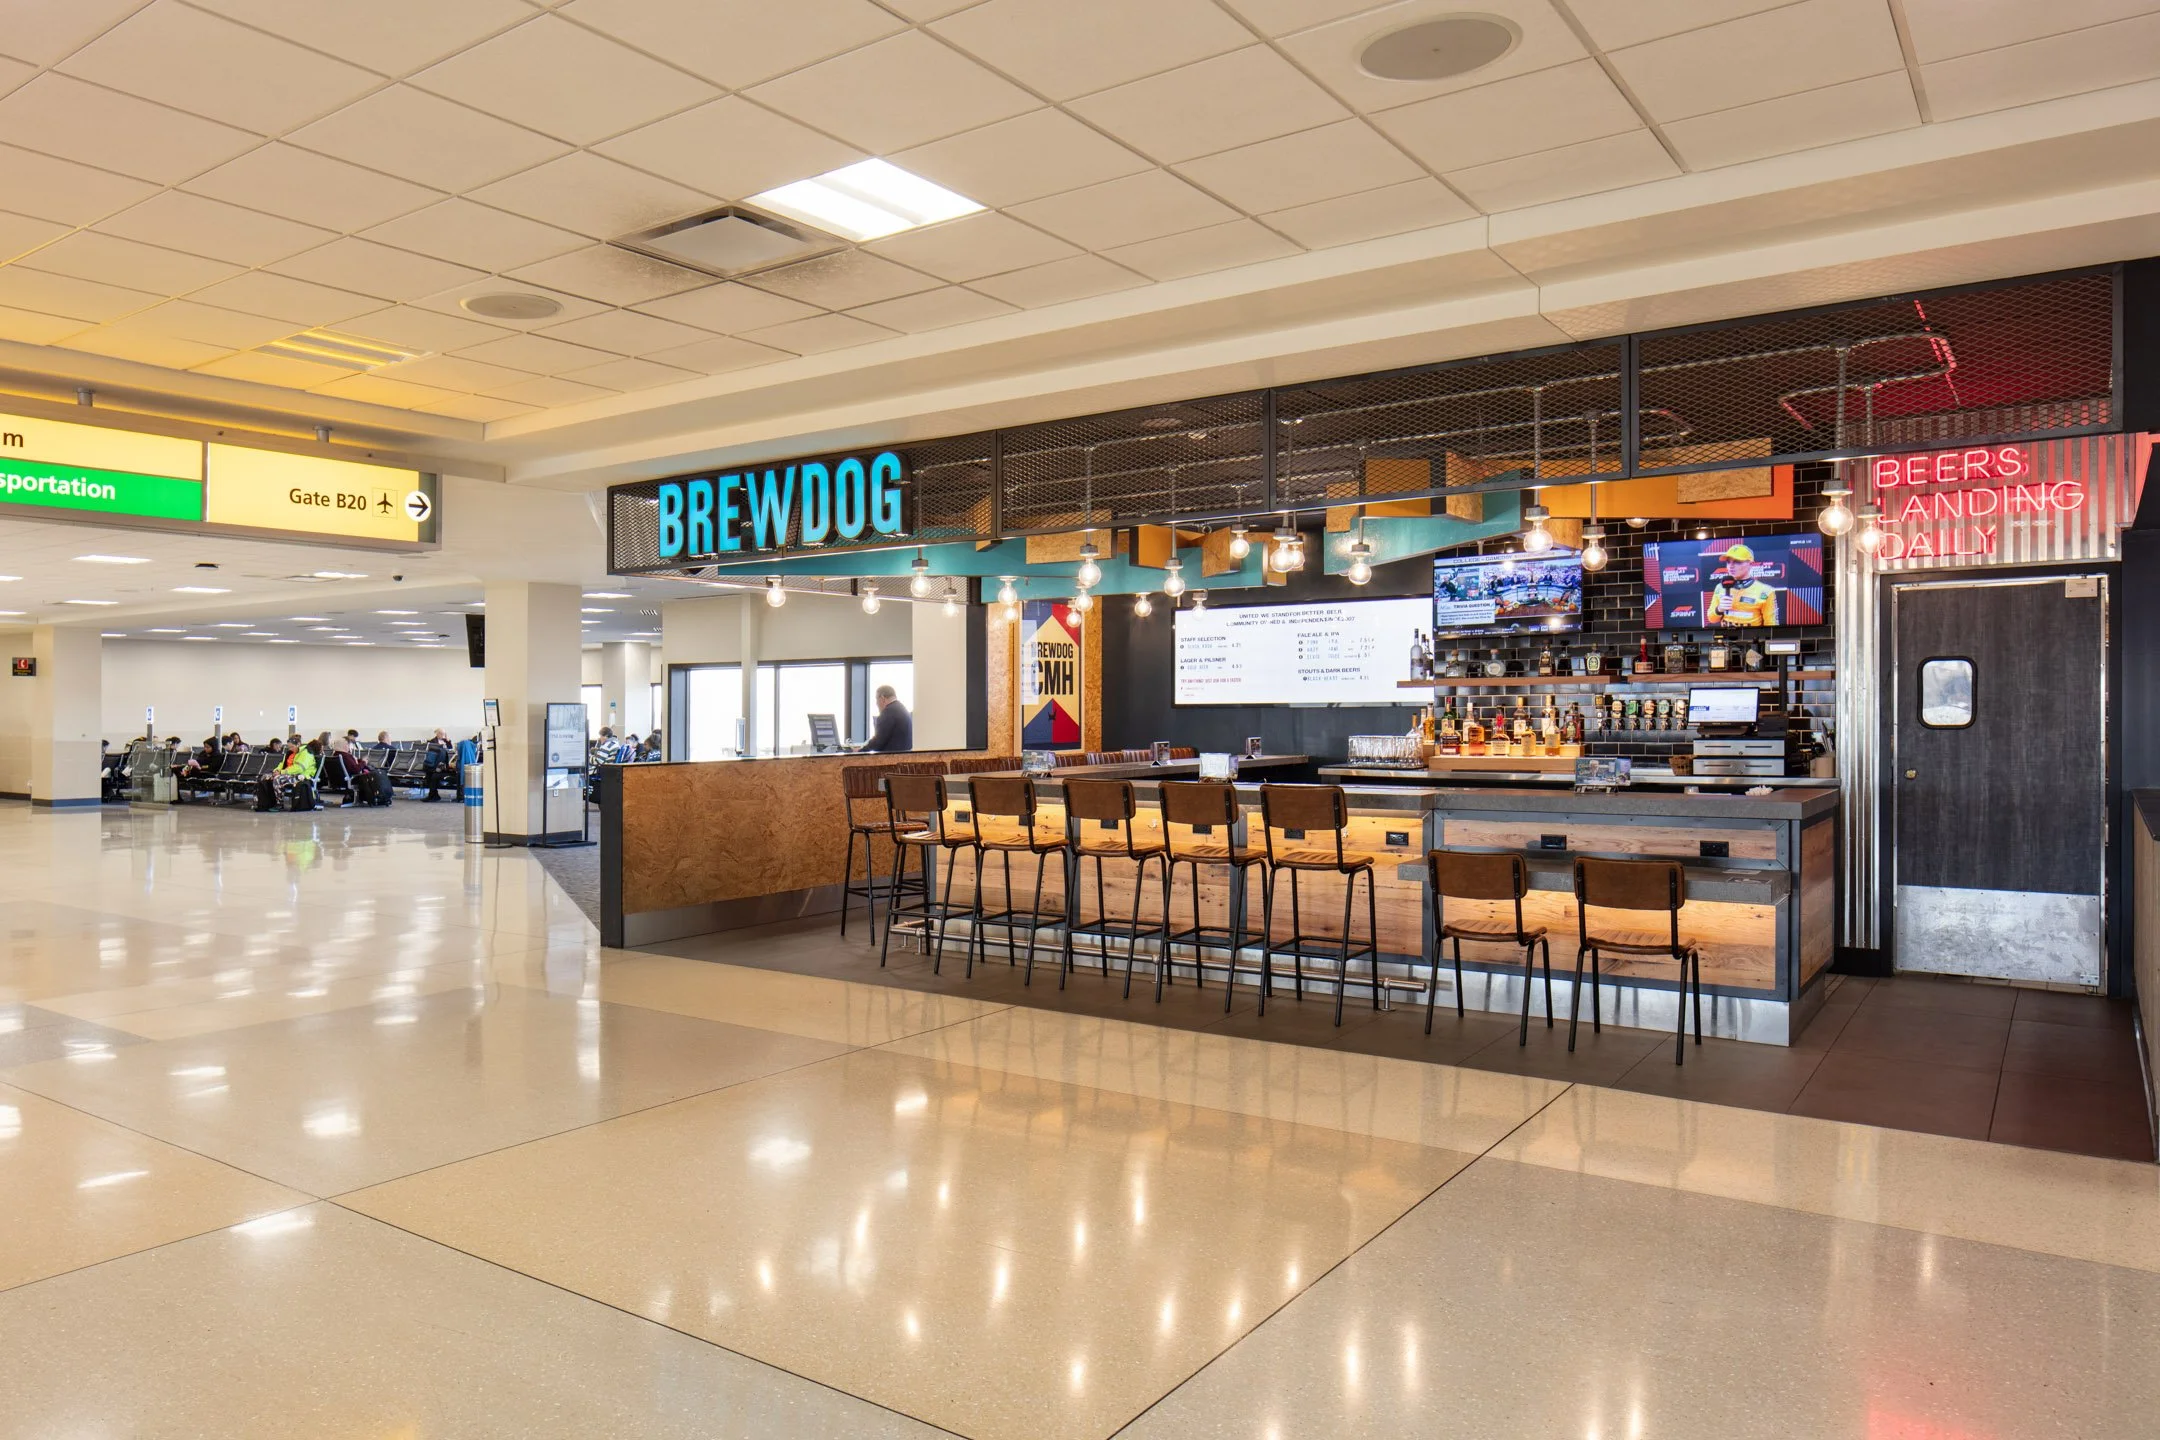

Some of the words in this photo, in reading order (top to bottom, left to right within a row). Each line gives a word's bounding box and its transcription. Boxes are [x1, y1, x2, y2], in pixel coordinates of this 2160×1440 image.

[3, 432, 24, 447] m
[1876, 447, 2022, 488] BEERS
[0, 472, 116, 500] sportation
[289, 488, 330, 508] Gate
[336, 493, 367, 511] B20
[1877, 480, 2085, 524] LANDING
[659, 451, 902, 558] BREWDOG
[1877, 525, 1996, 560] DAILY
[1031, 660, 1074, 695] CMH
